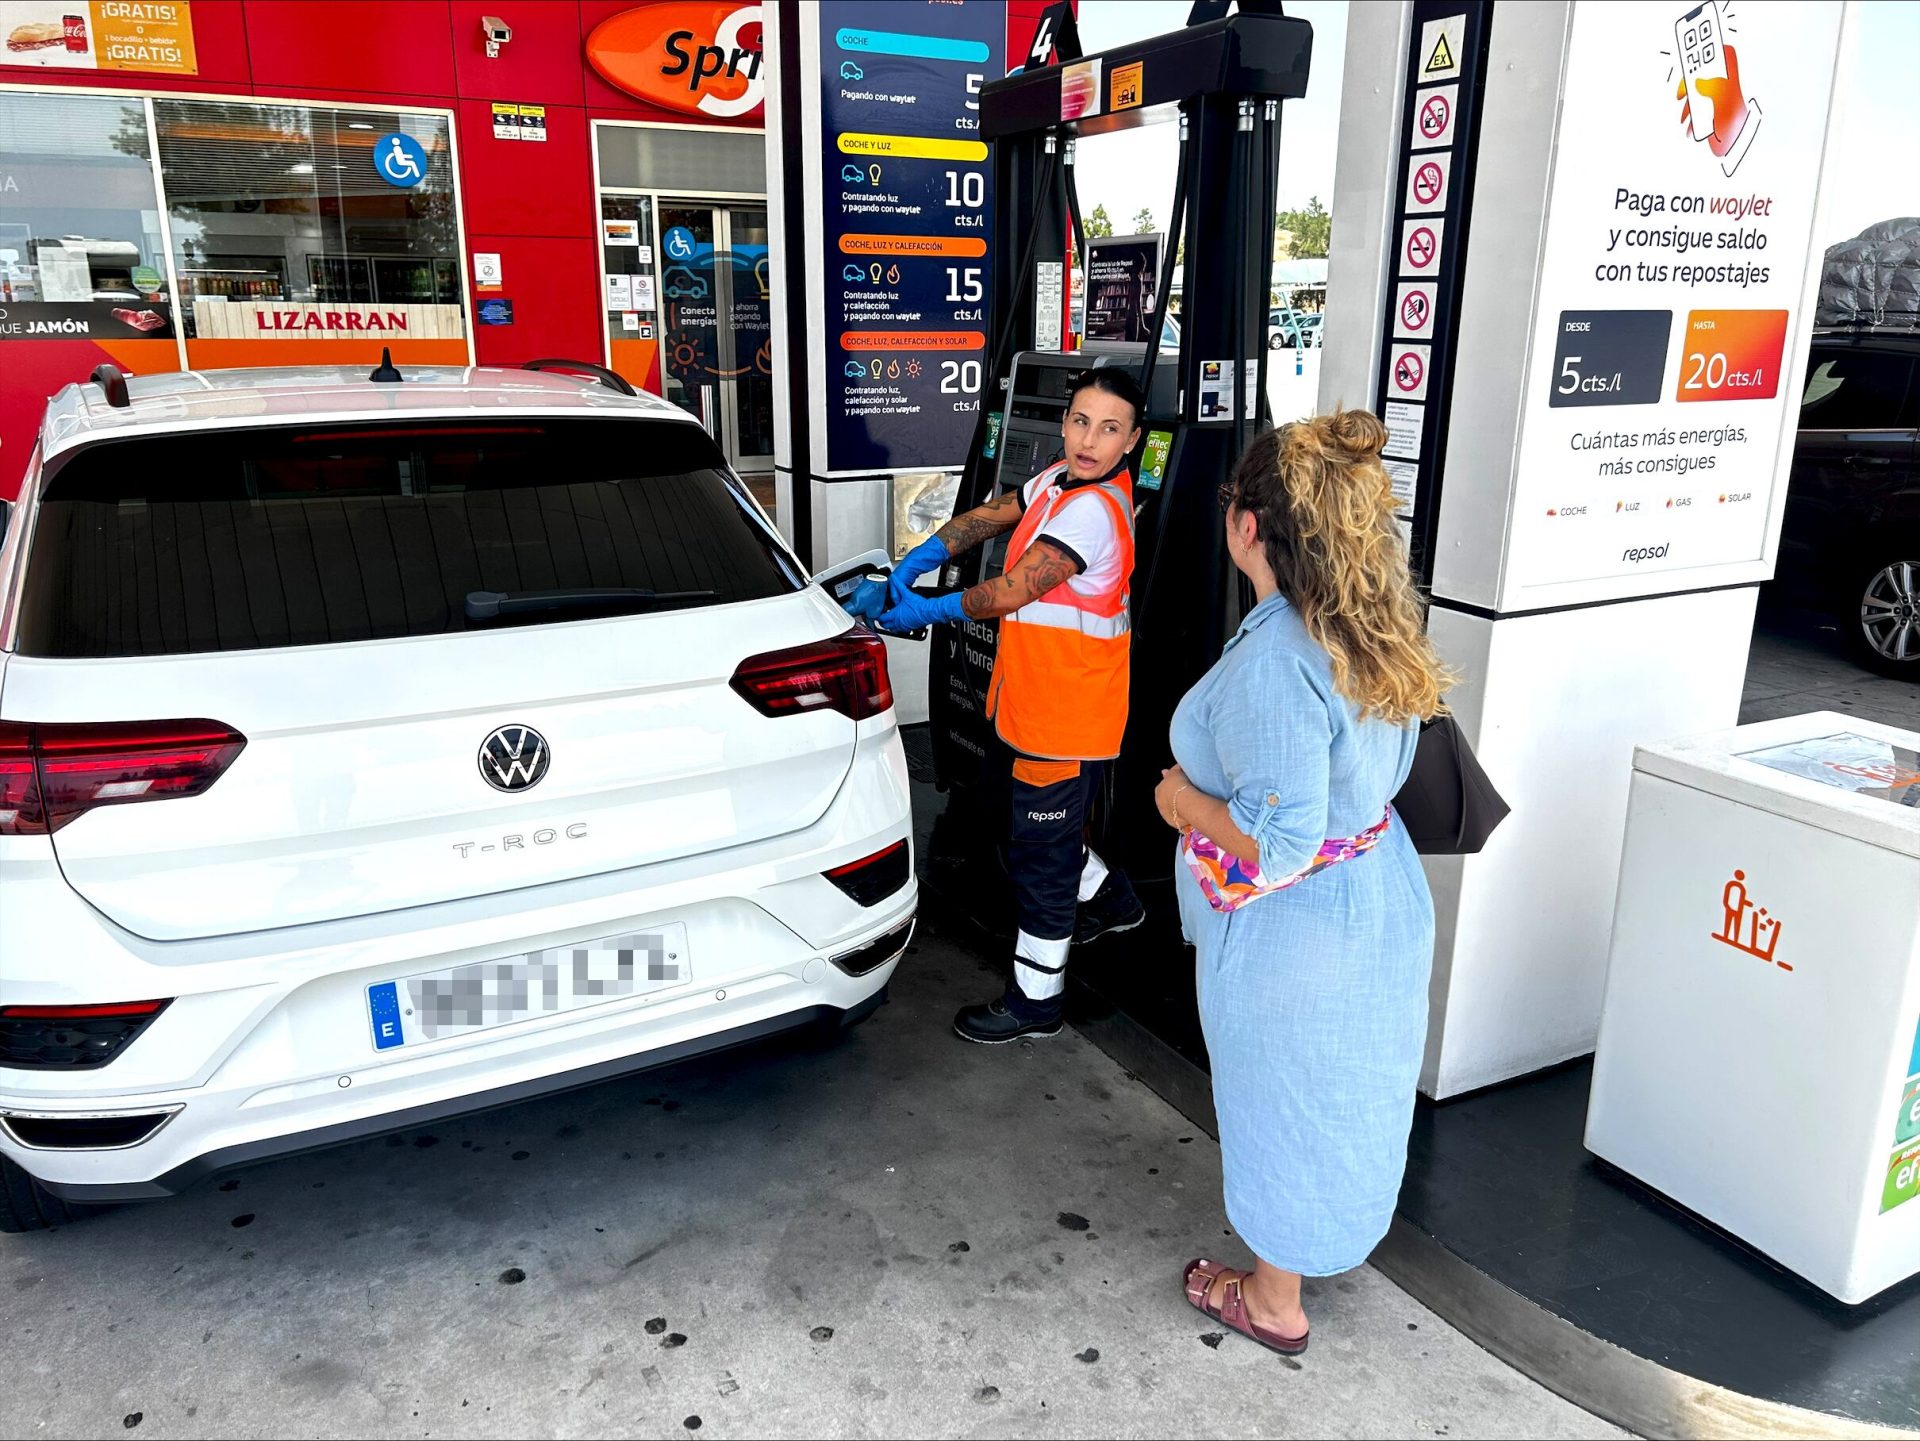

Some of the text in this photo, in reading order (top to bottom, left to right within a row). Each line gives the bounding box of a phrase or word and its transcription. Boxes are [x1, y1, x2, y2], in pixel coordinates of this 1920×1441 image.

[101, 2, 176, 20] ¡GRATIS!
[105, 34, 109, 42] 1
[110, 35, 143, 43] bocadillo
[842, 35, 869, 46] COCHE
[1030, 16, 1053, 63] 4
[106, 44, 182, 62] ¡GRATIS!
[660, 30, 765, 91] Spri
[1433, 53, 1447, 66] EX
[841, 90, 874, 101] Pagando
[874, 94, 888, 102] con
[964, 73, 984, 111] 5
[844, 139, 892, 150] COCHE Y LUZ
[945, 171, 985, 208] 10
[842, 192, 898, 203] Contratando luz
[842, 204, 847, 212] y
[848, 204, 880, 214] pagando
[1614, 188, 1773, 221] Paga con waylet
[954, 215, 984, 227] cts./l
[1606, 225, 1768, 253] y consigue saldo
[845, 240, 872, 250] COCHE,
[873, 241, 887, 249] LUZ
[895, 240, 943, 251] CALEFACCIÓN
[1595, 261, 1770, 288] con tus repostajes
[945, 267, 983, 303] 15
[843, 291, 898, 300] Contratando luz
[680, 306, 716, 315] Conecta
[850, 302, 890, 310] calefacción
[730, 312, 760, 322] pagando
[844, 313, 848, 321] y
[850, 312, 880, 322] pagando
[954, 308, 982, 320] cts./l
[0, 318, 89, 334] UE JAMÓN
[256, 311, 408, 330] LIZARRAN
[681, 316, 718, 328] energías
[1694, 320, 1716, 330] HASTA
[1565, 322, 1591, 332] DESDE
[846, 337, 873, 346] COCHE,
[890, 336, 938, 346] CALEFACCIÓN
[945, 337, 968, 345] SOLAR
[940, 360, 982, 394] 20
[844, 386, 887, 395] Contratando
[844, 396, 884, 404] calefacción
[891, 396, 908, 404] solar
[953, 400, 980, 412] cts./l
[844, 408, 850, 416] y
[850, 406, 880, 416] pagando
[991, 426, 1000, 436] 95
[1570, 423, 1748, 450] Cuántas más energías,
[1148, 438, 1168, 450] efitec
[1155, 450, 1166, 462] 98
[1598, 454, 1716, 476] más consigues
[1560, 493, 1752, 516] COCHE LUZ GAS SOLAR
[1622, 543, 1670, 563] repsol
[949, 640, 993, 672] y horra
[1028, 809, 1066, 822] repsol
[452, 822, 588, 859] T-ROC
[382, 1022, 395, 1038] E
